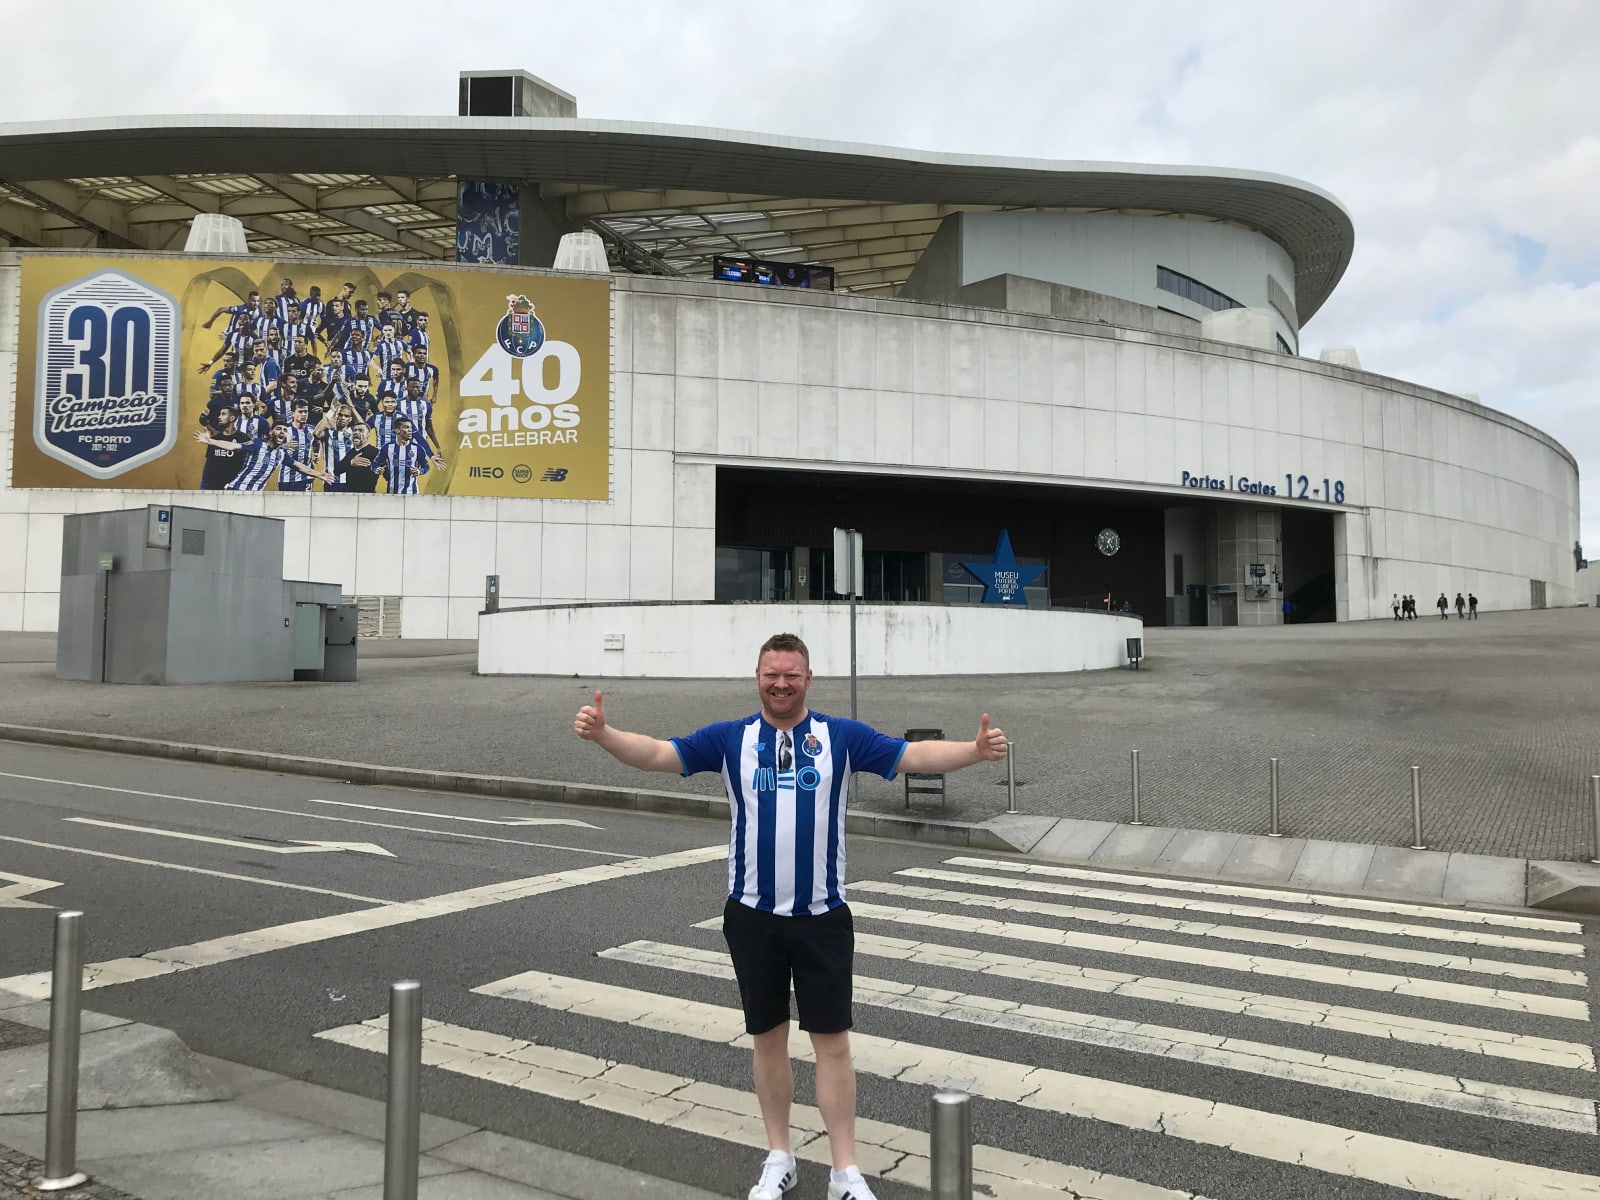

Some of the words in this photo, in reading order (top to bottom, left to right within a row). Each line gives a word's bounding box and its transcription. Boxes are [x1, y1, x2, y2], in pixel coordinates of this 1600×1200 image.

[66, 305, 150, 400] 30
[459, 340, 581, 406] 40
[52, 392, 159, 412] Campeão
[54, 407, 153, 430] Nacional
[458, 404, 580, 433] anos
[78, 435, 93, 443] FC
[94, 435, 131, 444] PORTO
[459, 434, 473, 449] A
[477, 429, 578, 448] CELEBRAR
[214, 449, 234, 457] MEO
[469, 466, 504, 479] MEO
[1181, 470, 1225, 491] Portas
[1237, 477, 1277, 496] Gates
[1285, 473, 1345, 504] 12-18
[994, 571, 1018, 579] MUSEU
[752, 765, 821, 791] MEO
